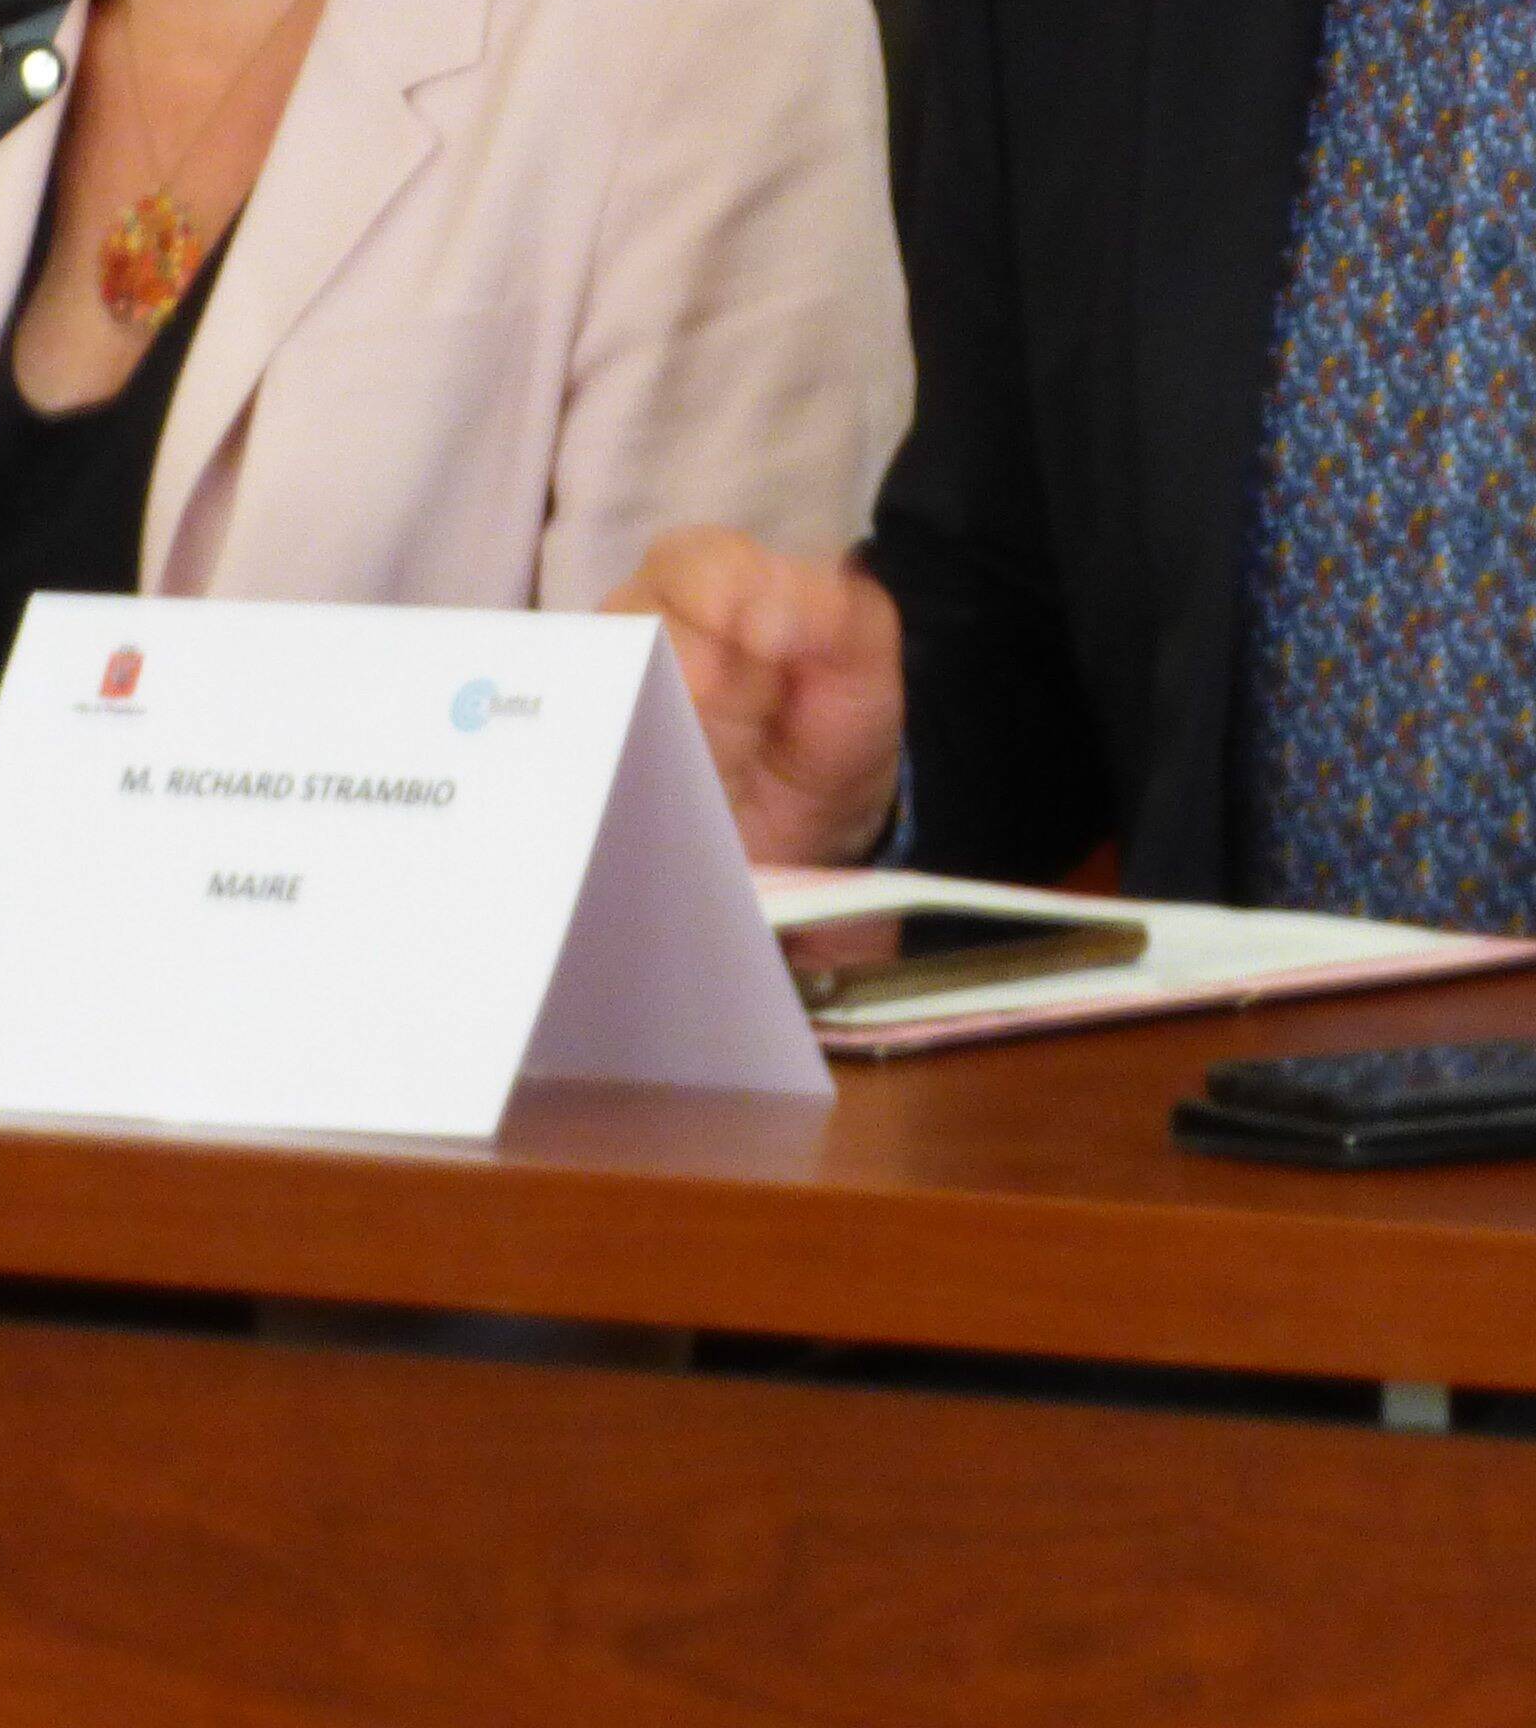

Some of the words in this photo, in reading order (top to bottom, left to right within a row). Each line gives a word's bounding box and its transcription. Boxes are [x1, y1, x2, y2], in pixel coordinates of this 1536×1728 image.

[118, 766, 152, 794] M.
[164, 768, 295, 801] RICHARD
[300, 773, 456, 808] STRAMBIO
[206, 871, 301, 903] MAIRE
